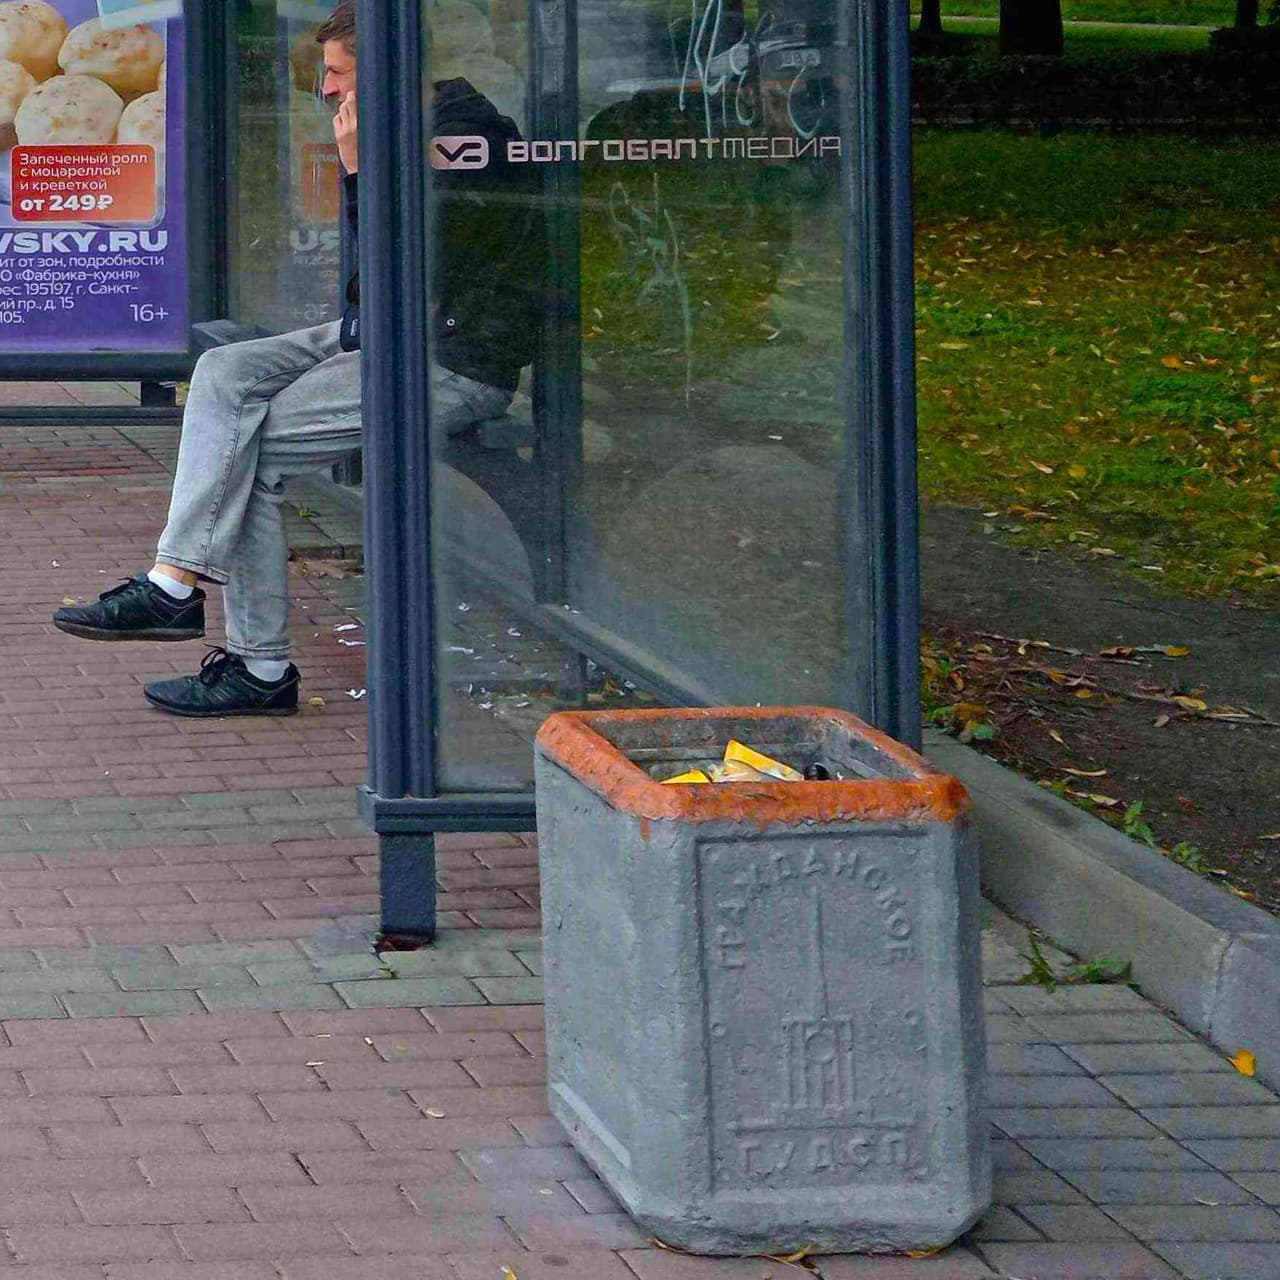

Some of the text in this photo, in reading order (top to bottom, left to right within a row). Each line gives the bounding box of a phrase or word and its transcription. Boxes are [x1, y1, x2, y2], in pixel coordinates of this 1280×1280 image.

[20, 153, 148, 166] Запеченный ролл
[20, 166, 121, 178] с моцареллой
[20, 179, 107, 192] и креветкой
[20, 199, 45, 211] от
[18, 257, 35, 268] от
[69, 254, 165, 269] подробности
[88, 282, 140, 295] Санкт-
[59, 297, 75, 309] 15
[130, 303, 169, 322] 16+
